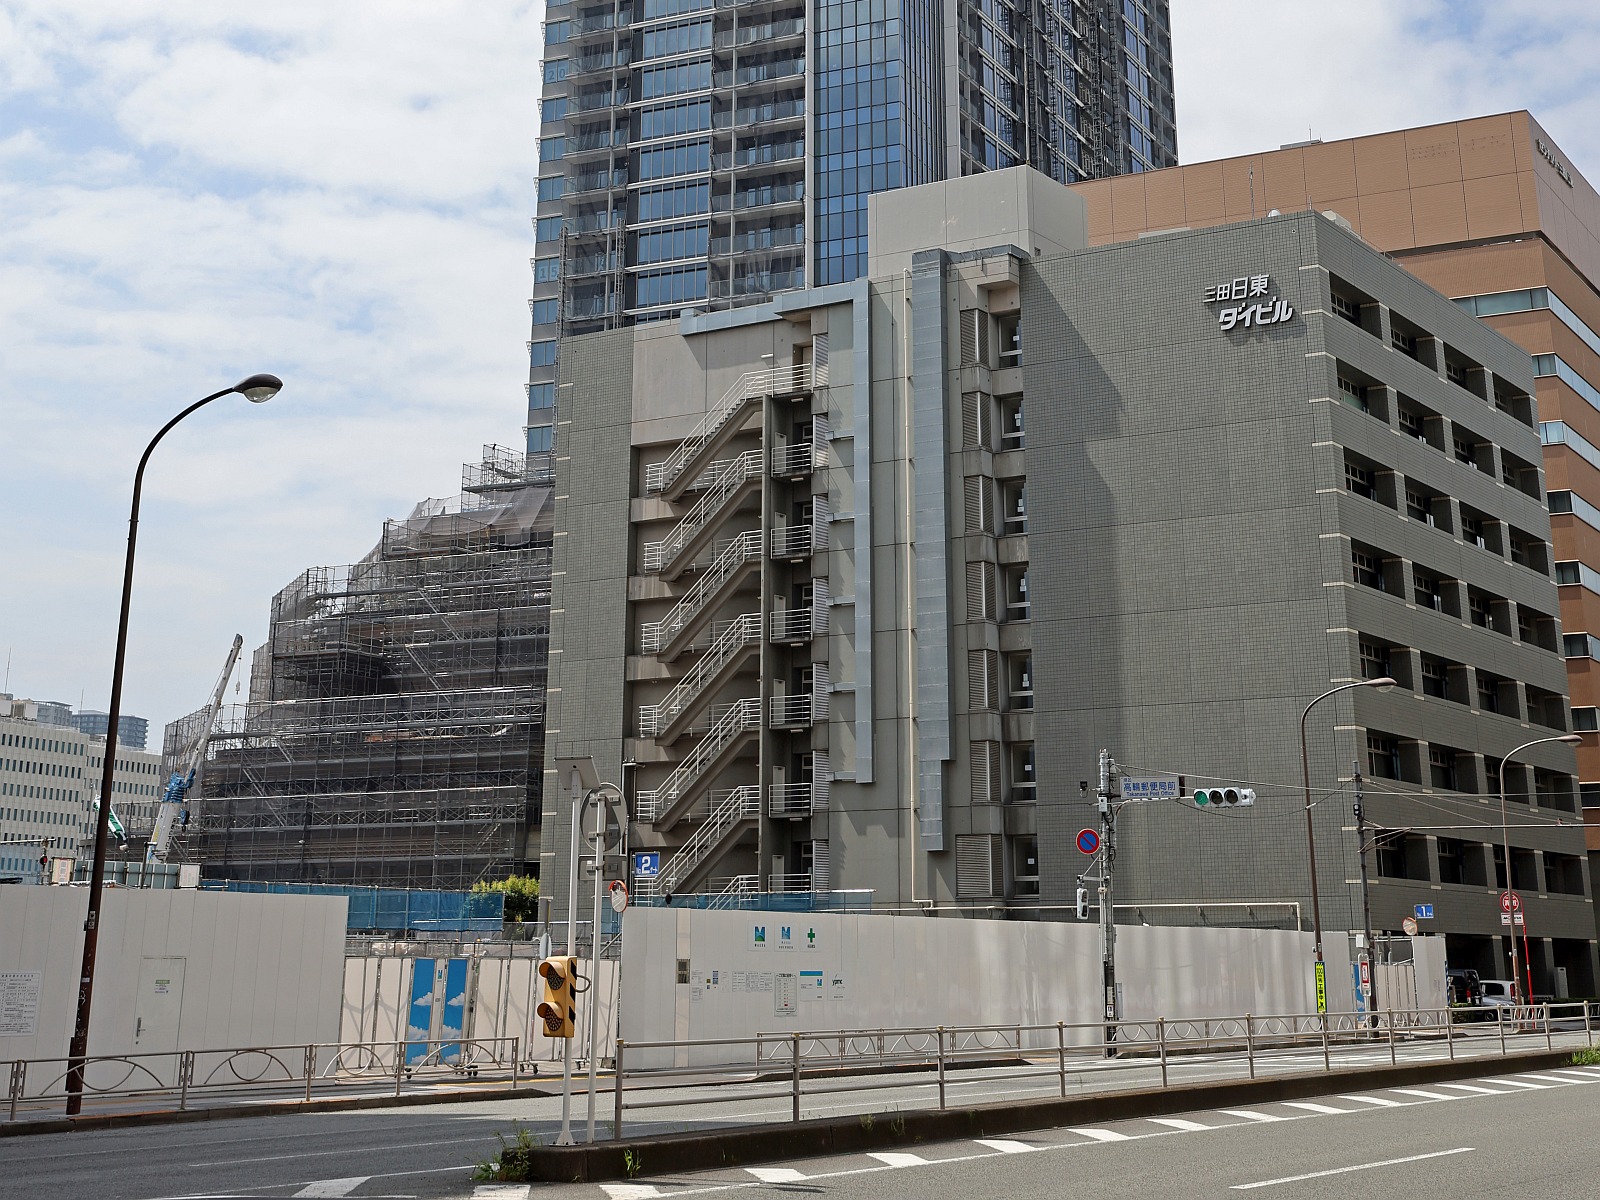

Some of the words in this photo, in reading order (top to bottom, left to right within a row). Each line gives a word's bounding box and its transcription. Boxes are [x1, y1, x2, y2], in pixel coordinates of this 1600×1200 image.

[1203, 274, 1270, 303] 三田日東
[1219, 296, 1293, 330] ダイビル
[1123, 781, 1176, 791] 高輪郵便局前
